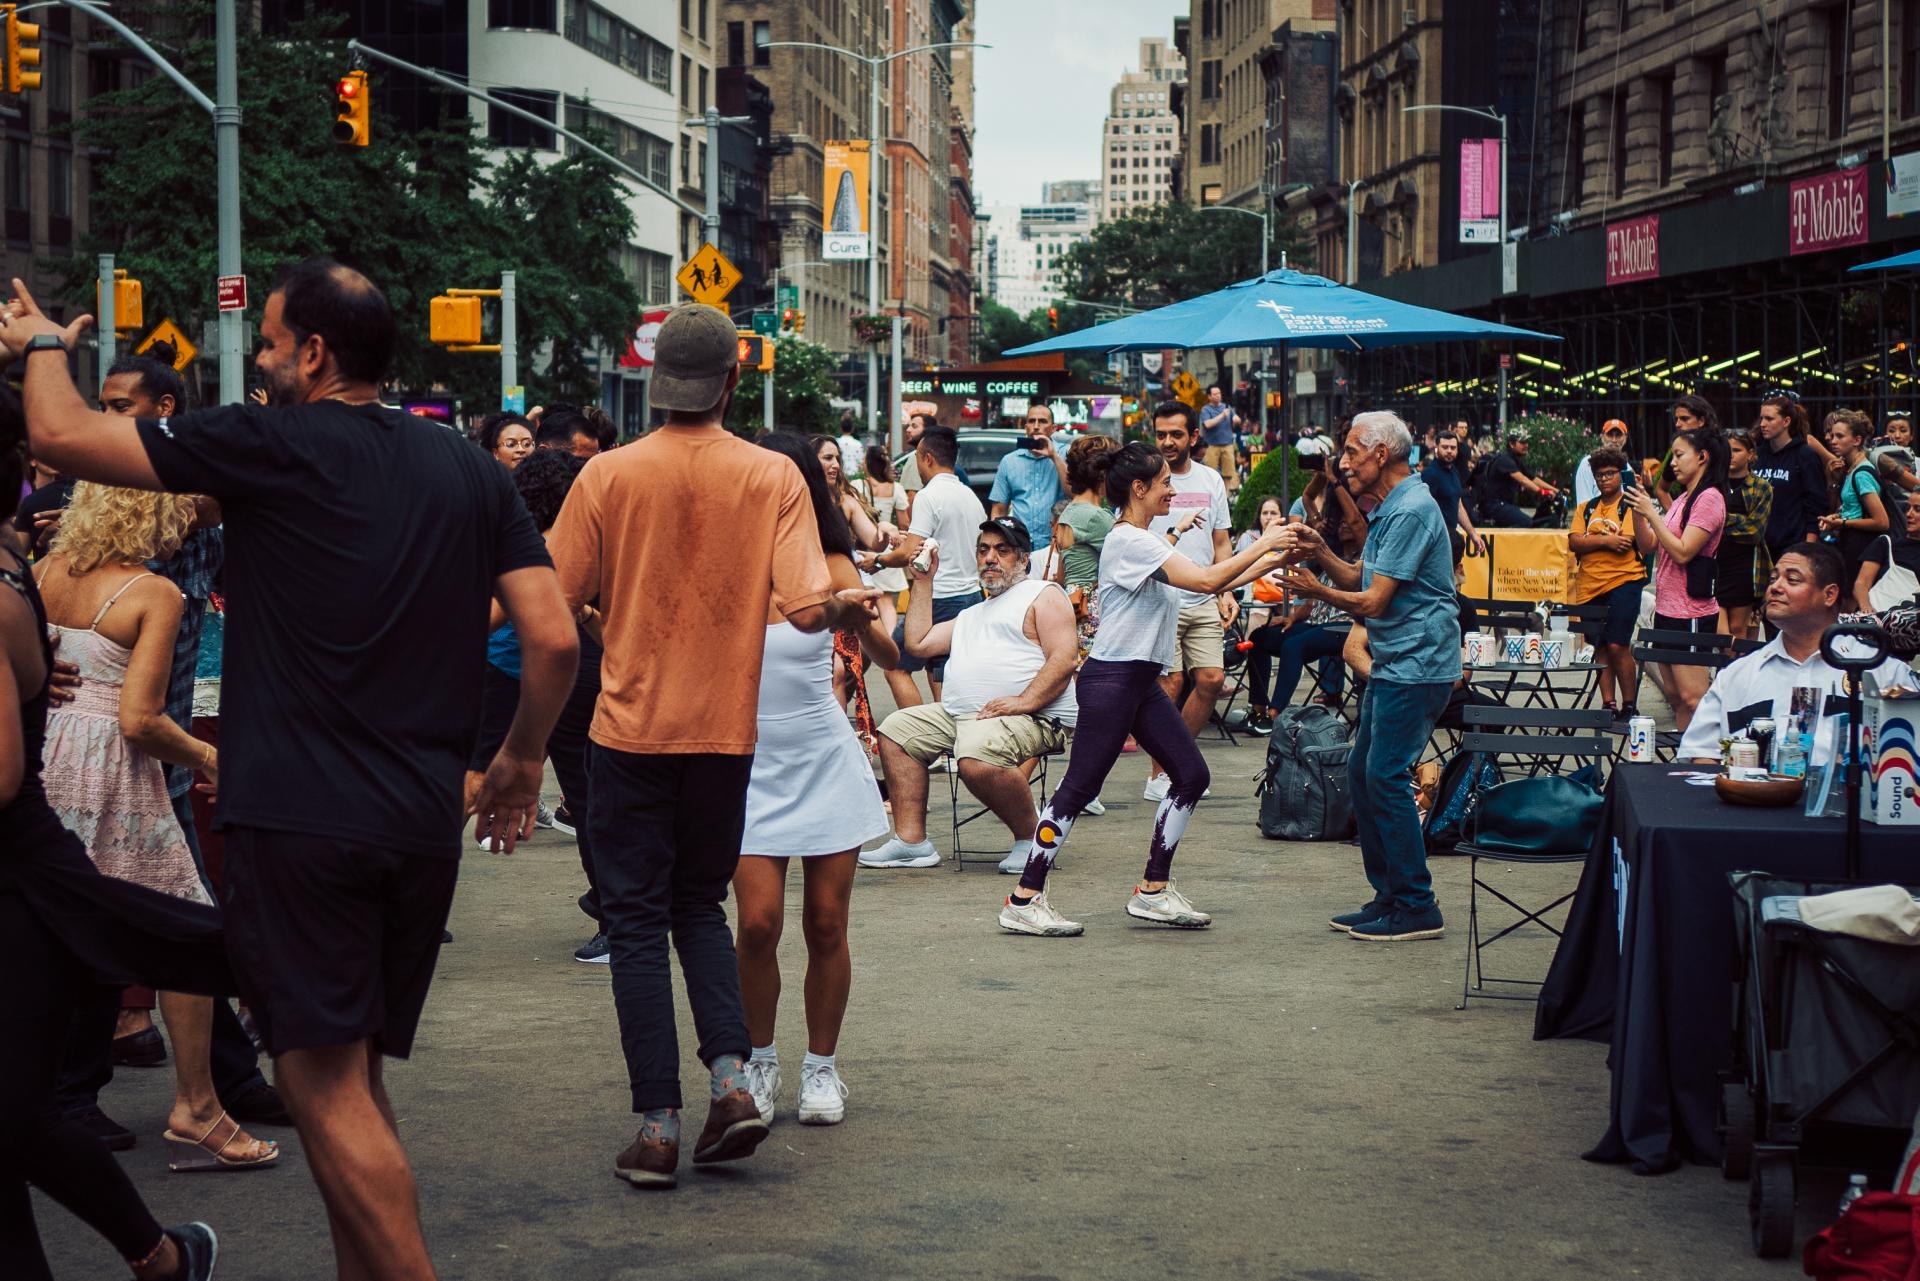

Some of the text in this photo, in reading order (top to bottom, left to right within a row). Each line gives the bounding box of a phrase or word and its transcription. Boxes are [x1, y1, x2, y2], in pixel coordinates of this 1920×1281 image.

[830, 241, 861, 253] Cure
[942, 382, 977, 393] WINE
[986, 382, 1038, 393] COFFEE
[1498, 568, 1516, 576] Take
[1517, 568, 1525, 576] in
[1526, 568, 1539, 576] the
[1498, 577, 1521, 585] where
[1523, 586, 1538, 594] New
[1890, 776, 1902, 819] Sound
